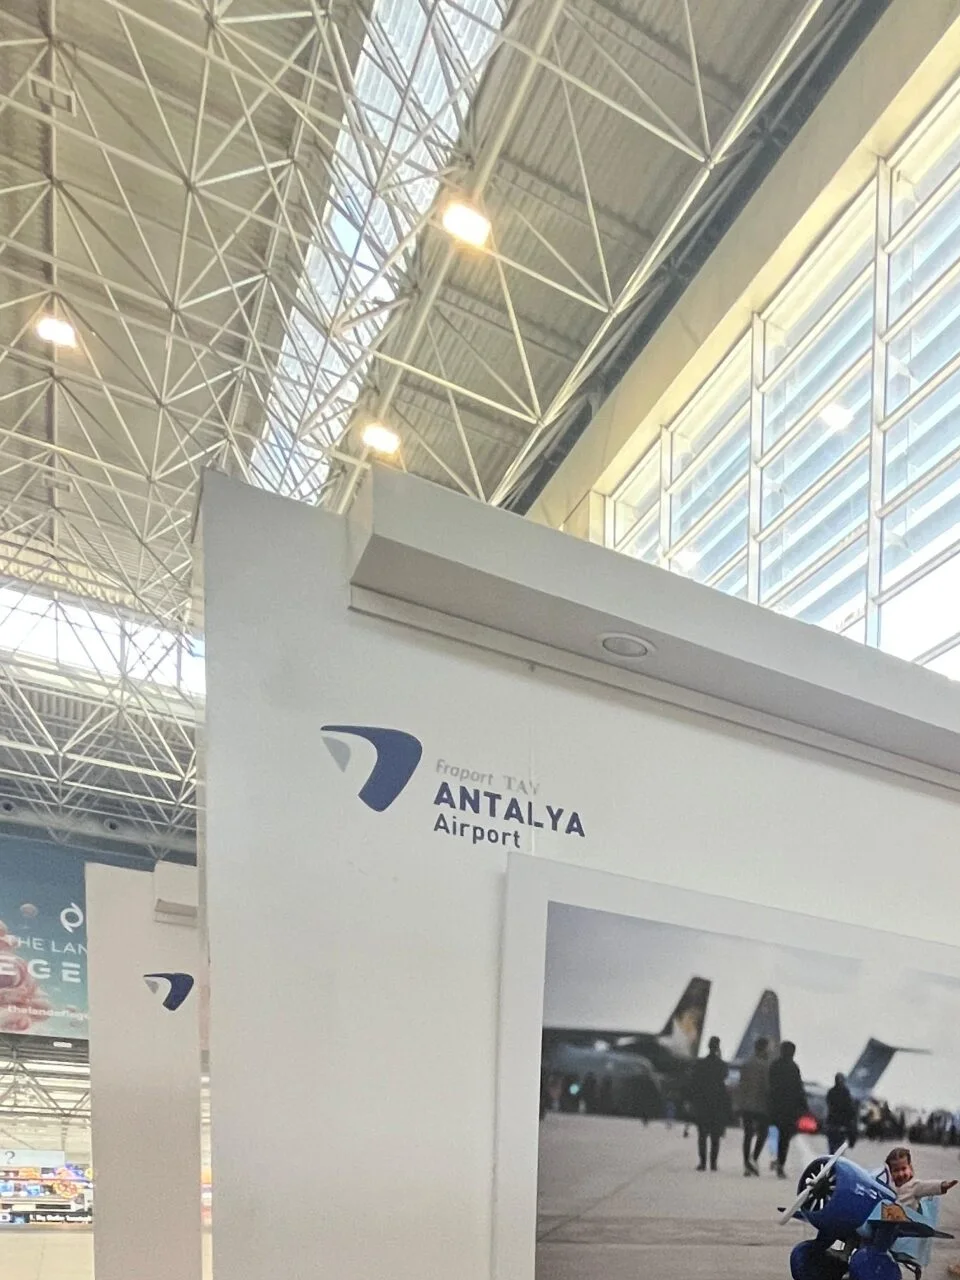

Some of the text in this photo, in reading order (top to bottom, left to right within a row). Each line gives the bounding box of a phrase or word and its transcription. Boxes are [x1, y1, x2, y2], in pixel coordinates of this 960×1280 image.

[435, 758, 541, 796] Fraport TAV
[433, 781, 586, 838] ANTALYA
[433, 813, 521, 849] Airport
[7, 934, 45, 952] THE
